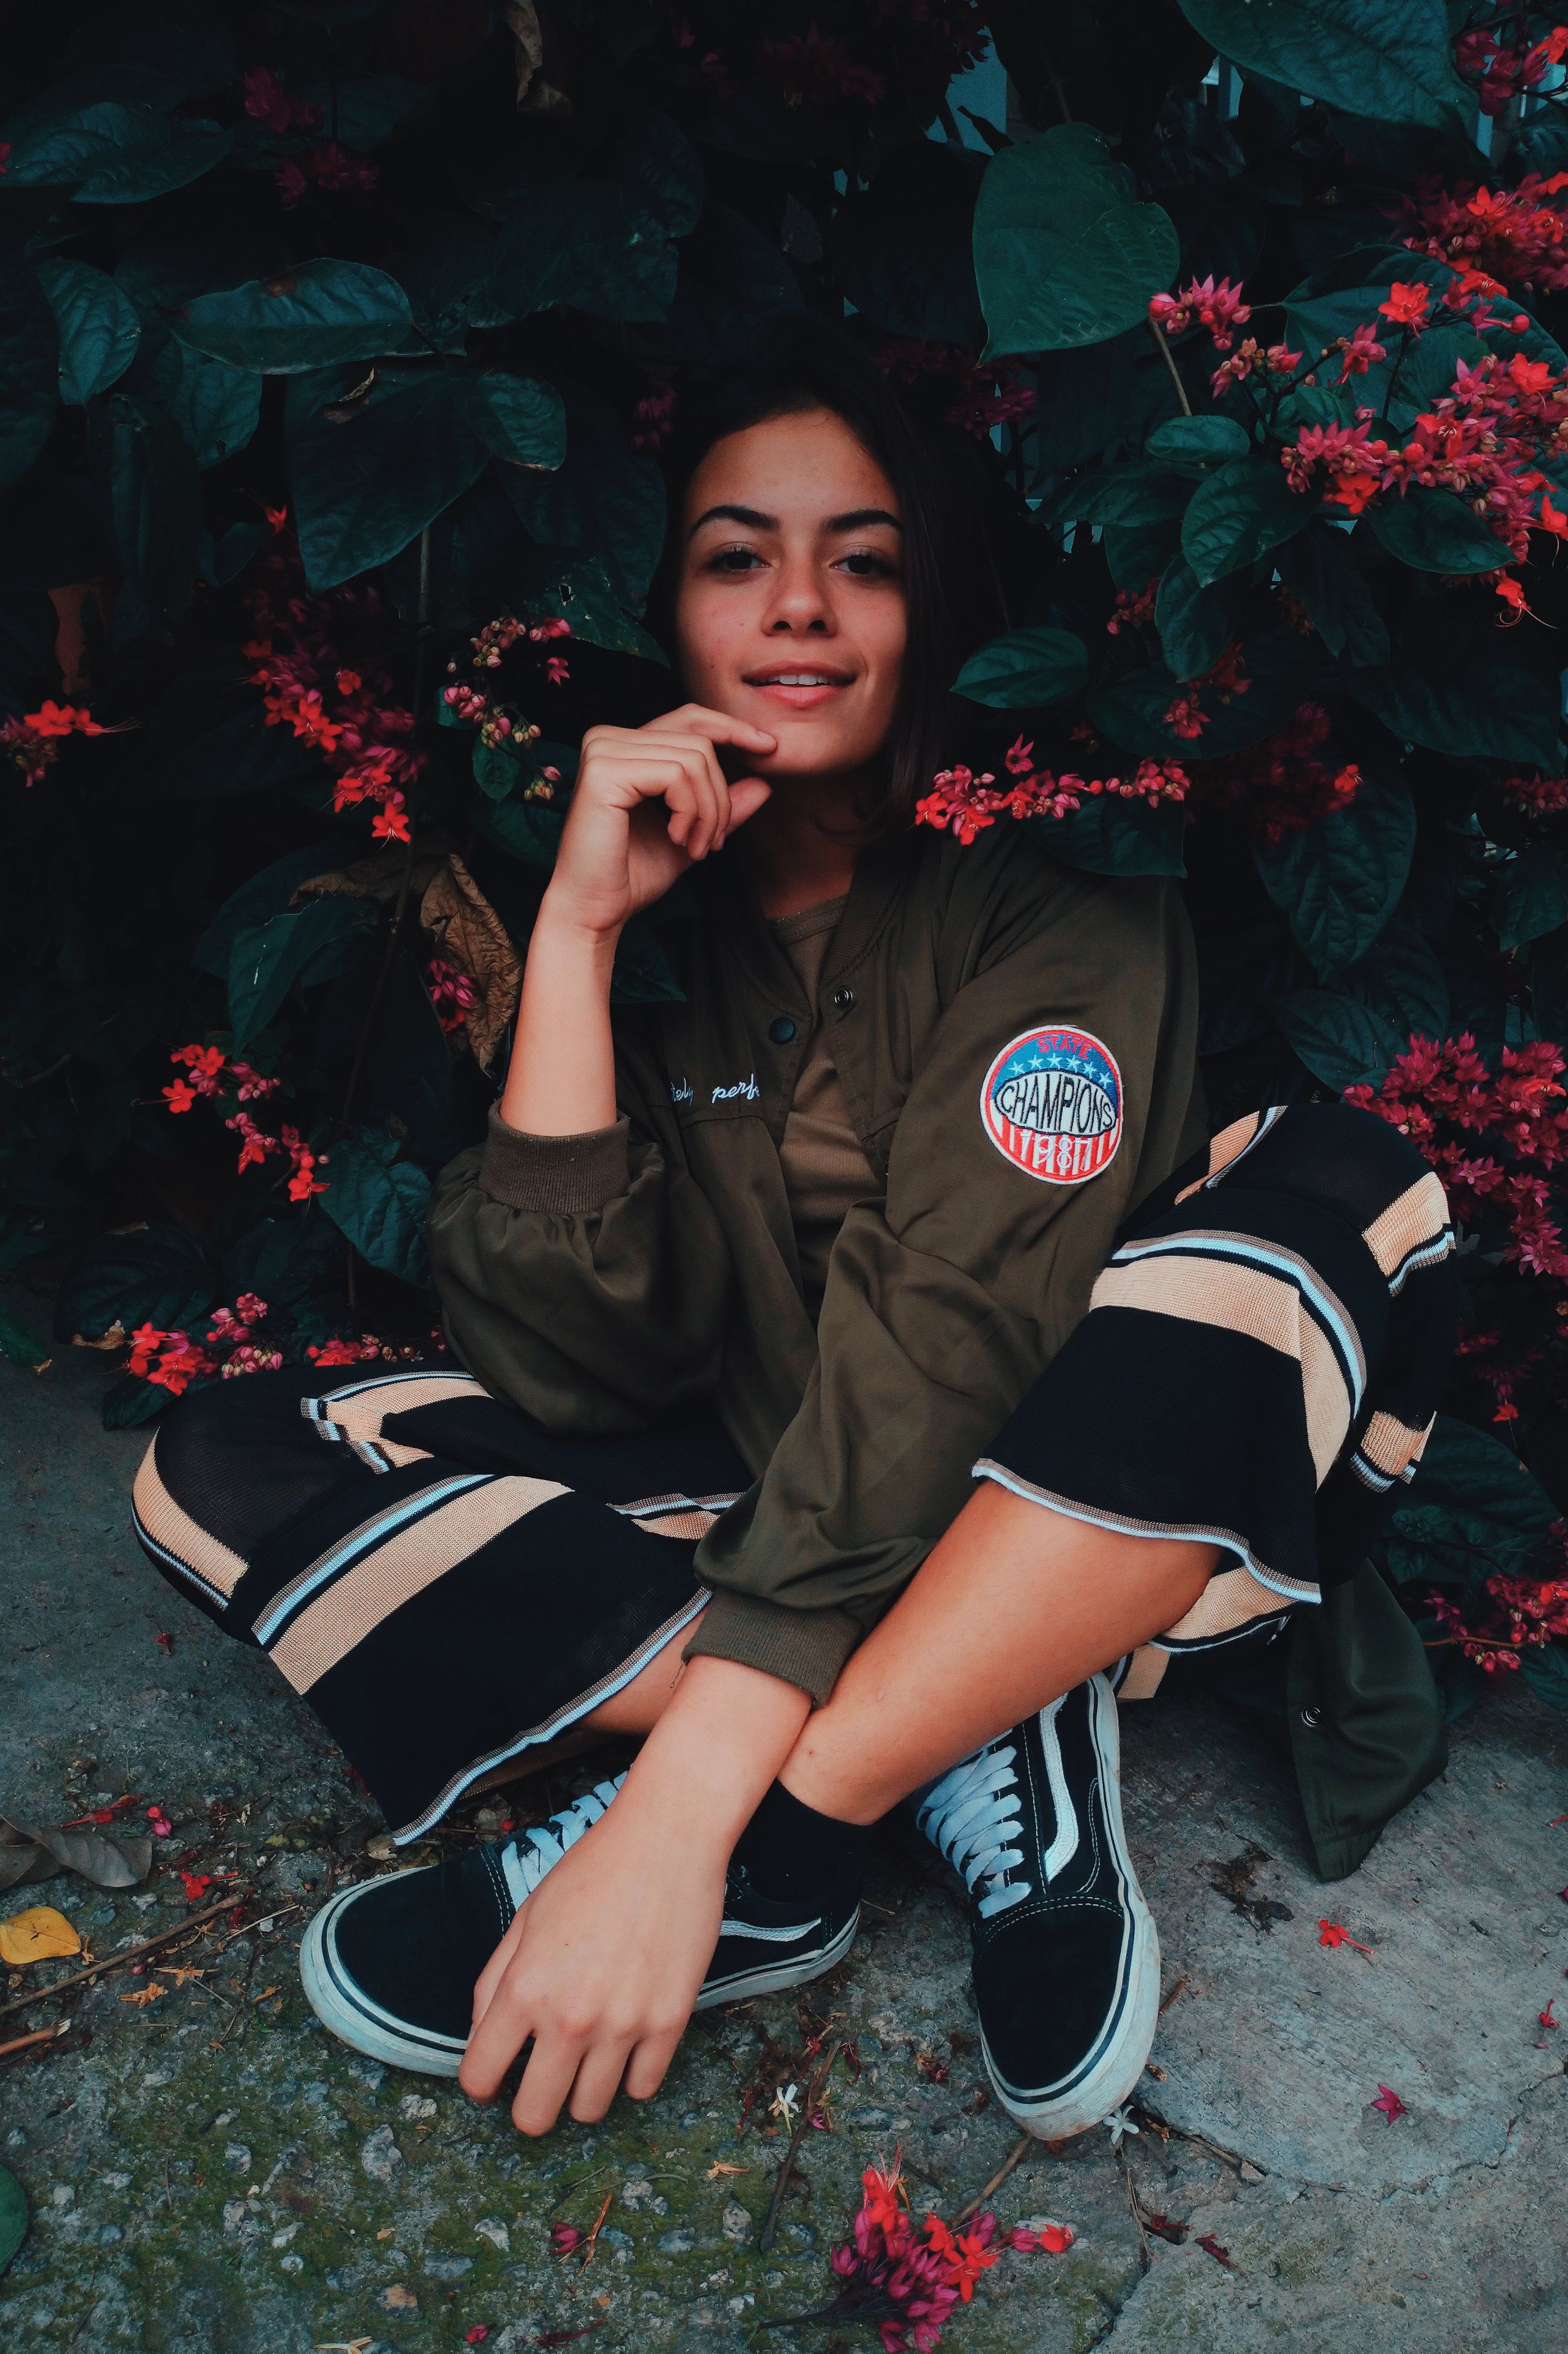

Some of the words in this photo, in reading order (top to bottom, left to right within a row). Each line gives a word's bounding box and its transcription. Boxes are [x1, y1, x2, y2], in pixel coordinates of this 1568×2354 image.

[1037, 1036, 1092, 1059] STATE
[1001, 1074, 1112, 1134] CHAMPIONS
[1020, 1134, 1093, 1171] 1987
